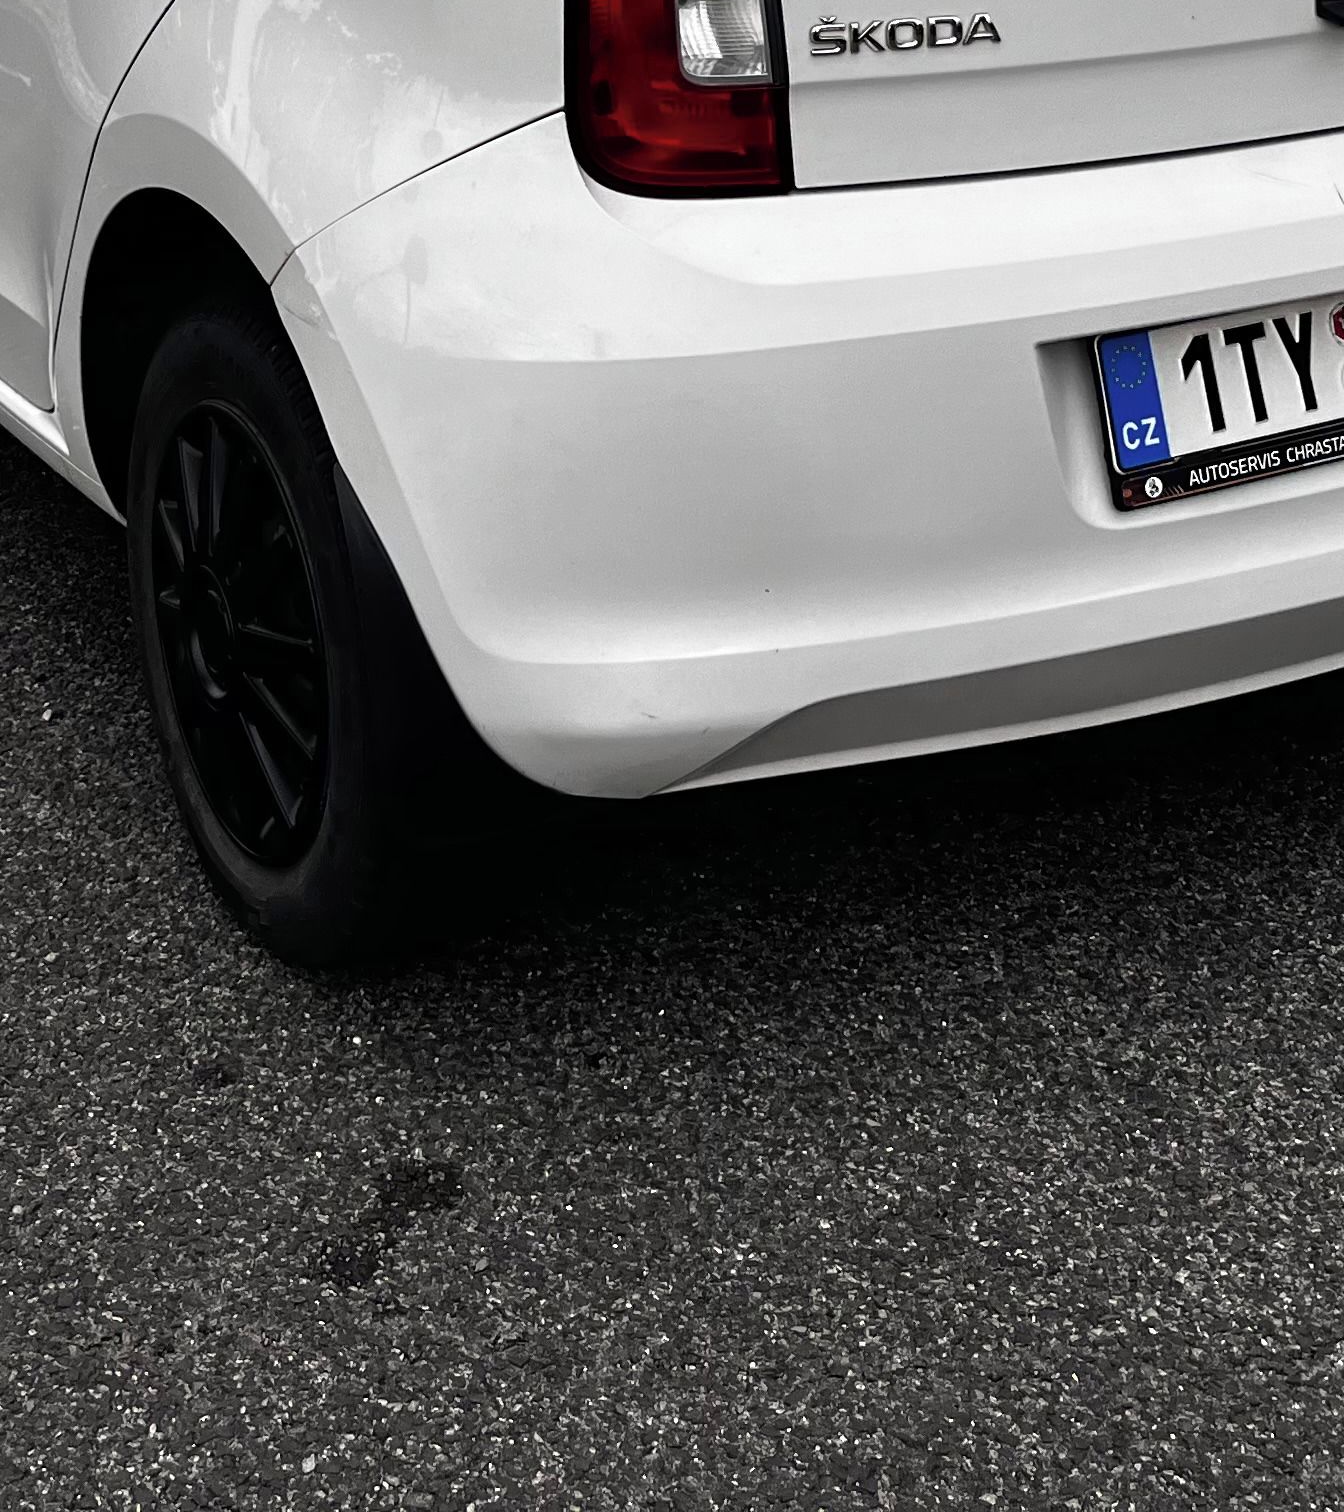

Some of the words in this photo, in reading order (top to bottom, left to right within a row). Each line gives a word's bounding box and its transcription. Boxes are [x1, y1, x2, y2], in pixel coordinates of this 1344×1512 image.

[809, 13, 1002, 57] ŠKODA
[1180, 311, 1318, 433] 1TY
[1122, 416, 1160, 450] CZ
[1189, 450, 1281, 486] AUTOSERVIS
